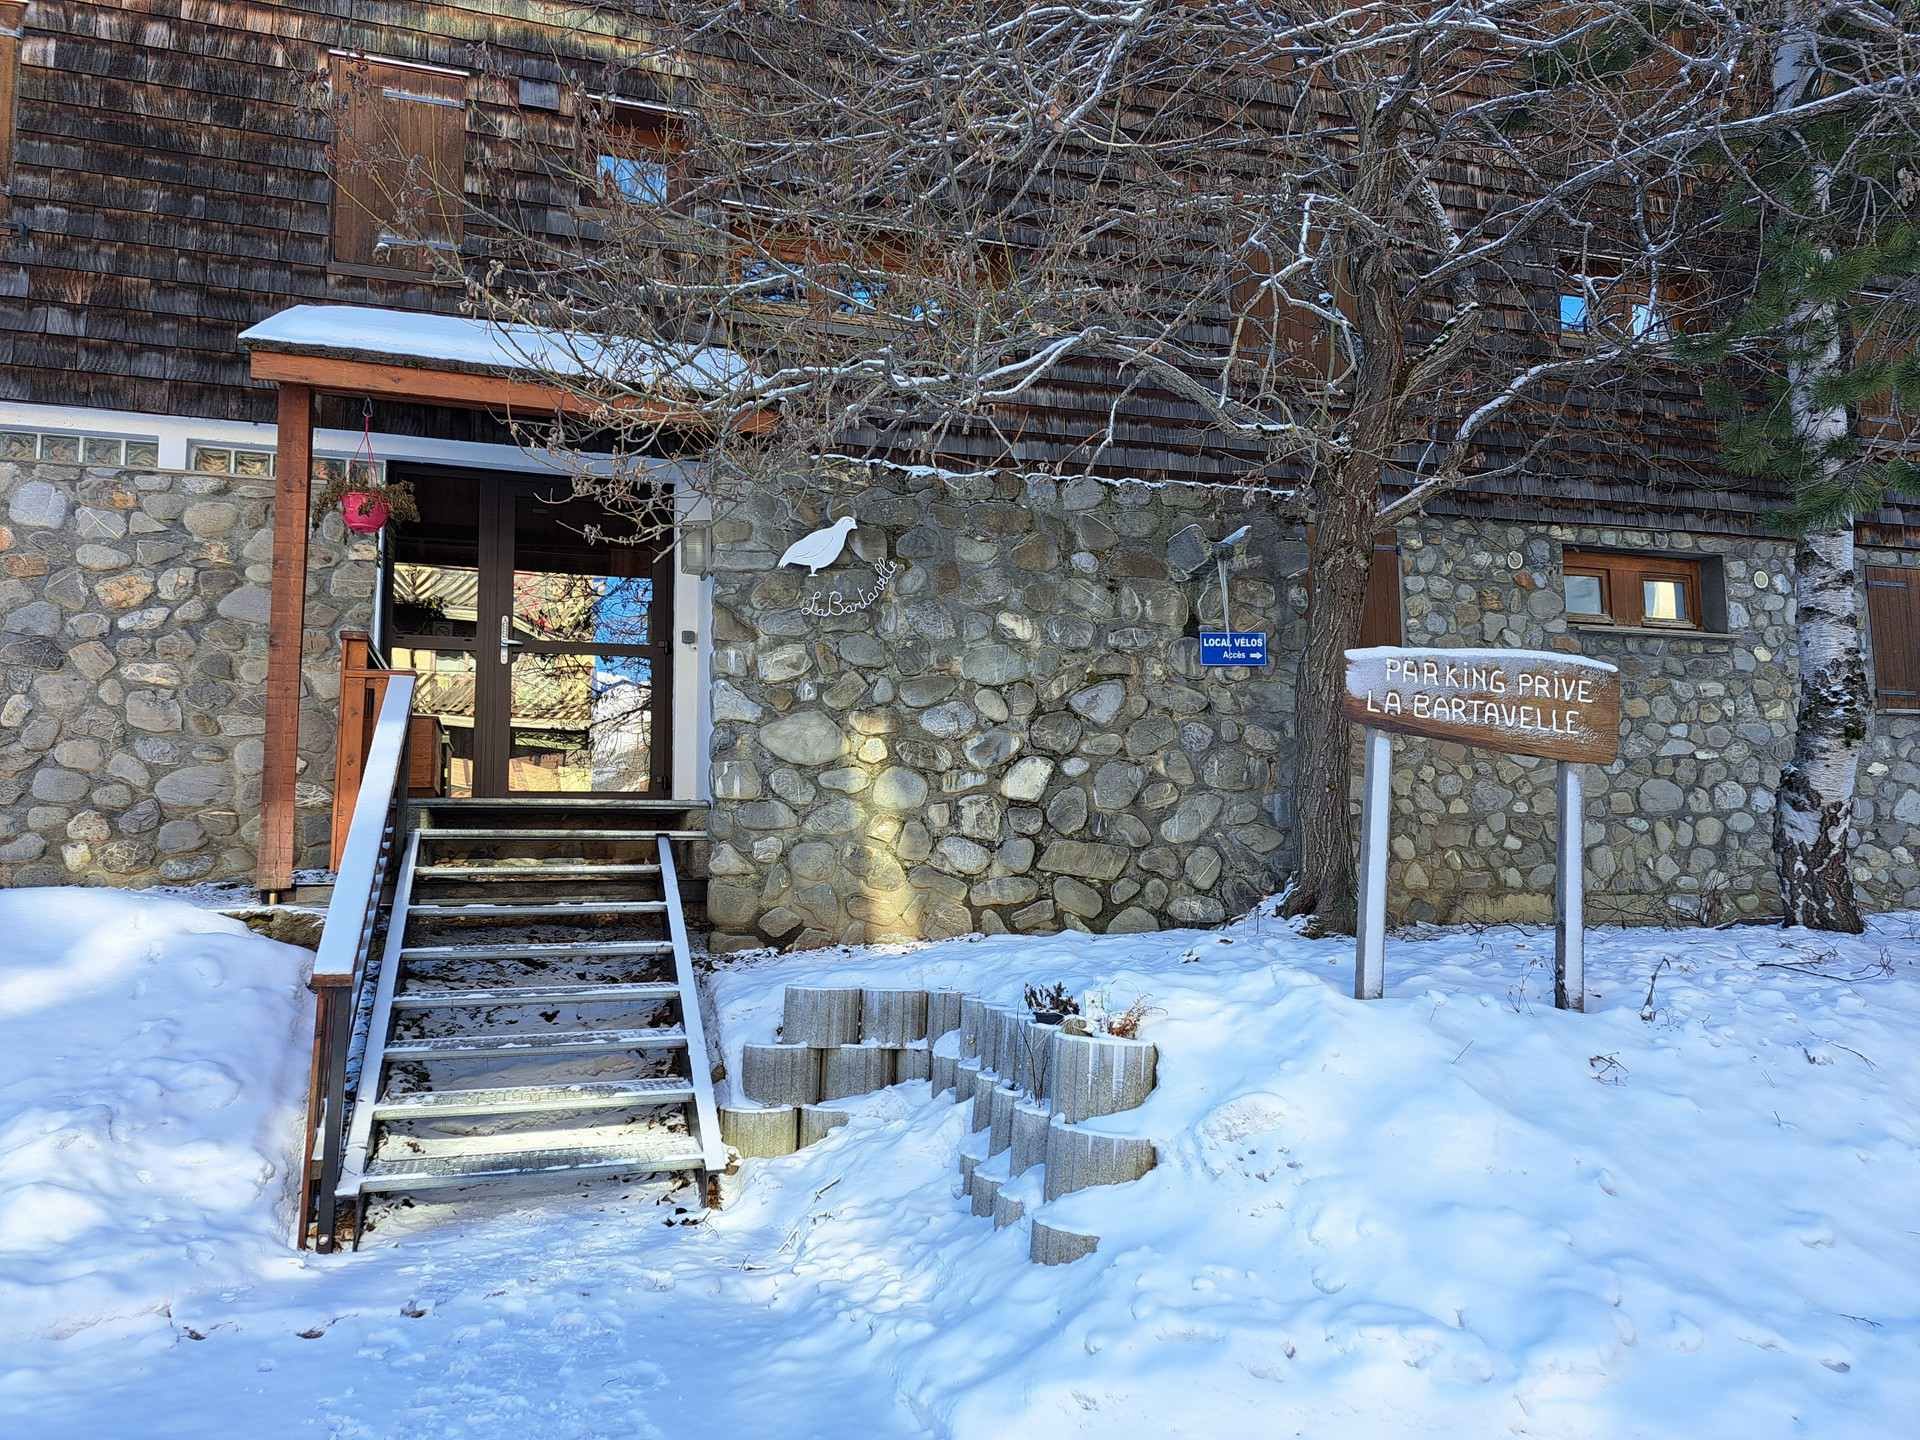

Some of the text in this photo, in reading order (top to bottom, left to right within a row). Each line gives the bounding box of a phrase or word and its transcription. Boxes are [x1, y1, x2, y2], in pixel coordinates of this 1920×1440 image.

[1203, 636, 1263, 647] LOCAL VÉLOS
[1223, 650, 1246, 659] Accès
[1366, 690, 1580, 734] LA BARTAVELLE
